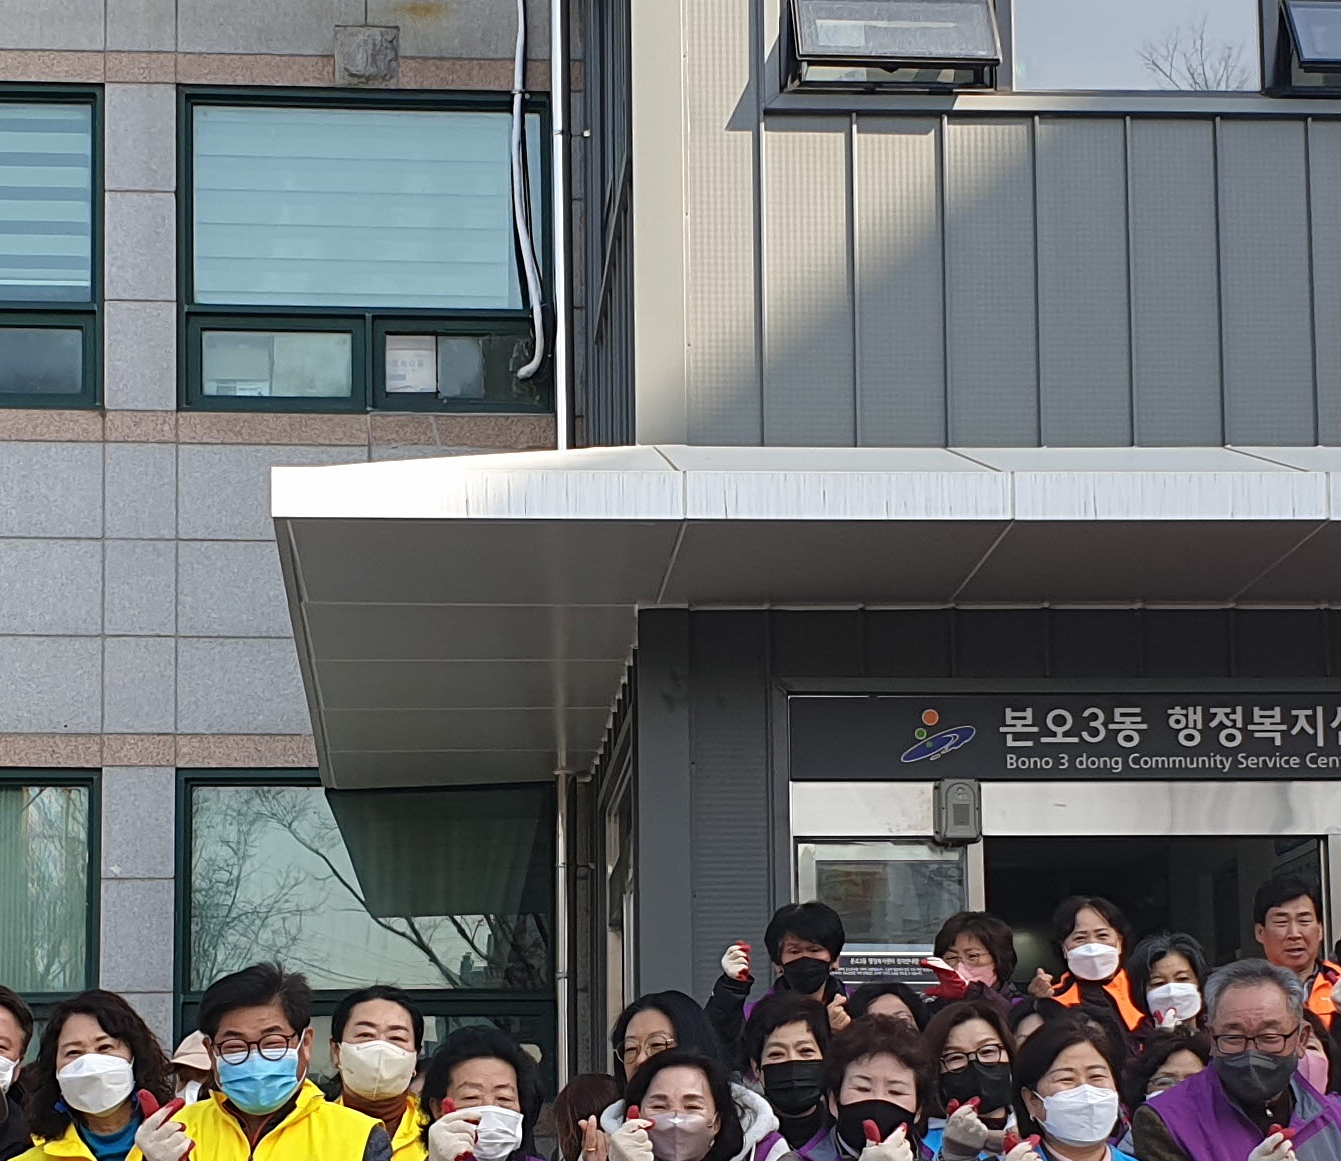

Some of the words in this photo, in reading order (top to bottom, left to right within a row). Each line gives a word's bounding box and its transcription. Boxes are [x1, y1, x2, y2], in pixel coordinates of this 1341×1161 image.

[999, 707, 1148, 748] 본오3동
[1006, 753, 1053, 770] Bono
[1058, 754, 1069, 769] 3
[1075, 753, 1122, 773] dong
[1128, 753, 1231, 773] Community
[1236, 752, 1299, 769] Service
